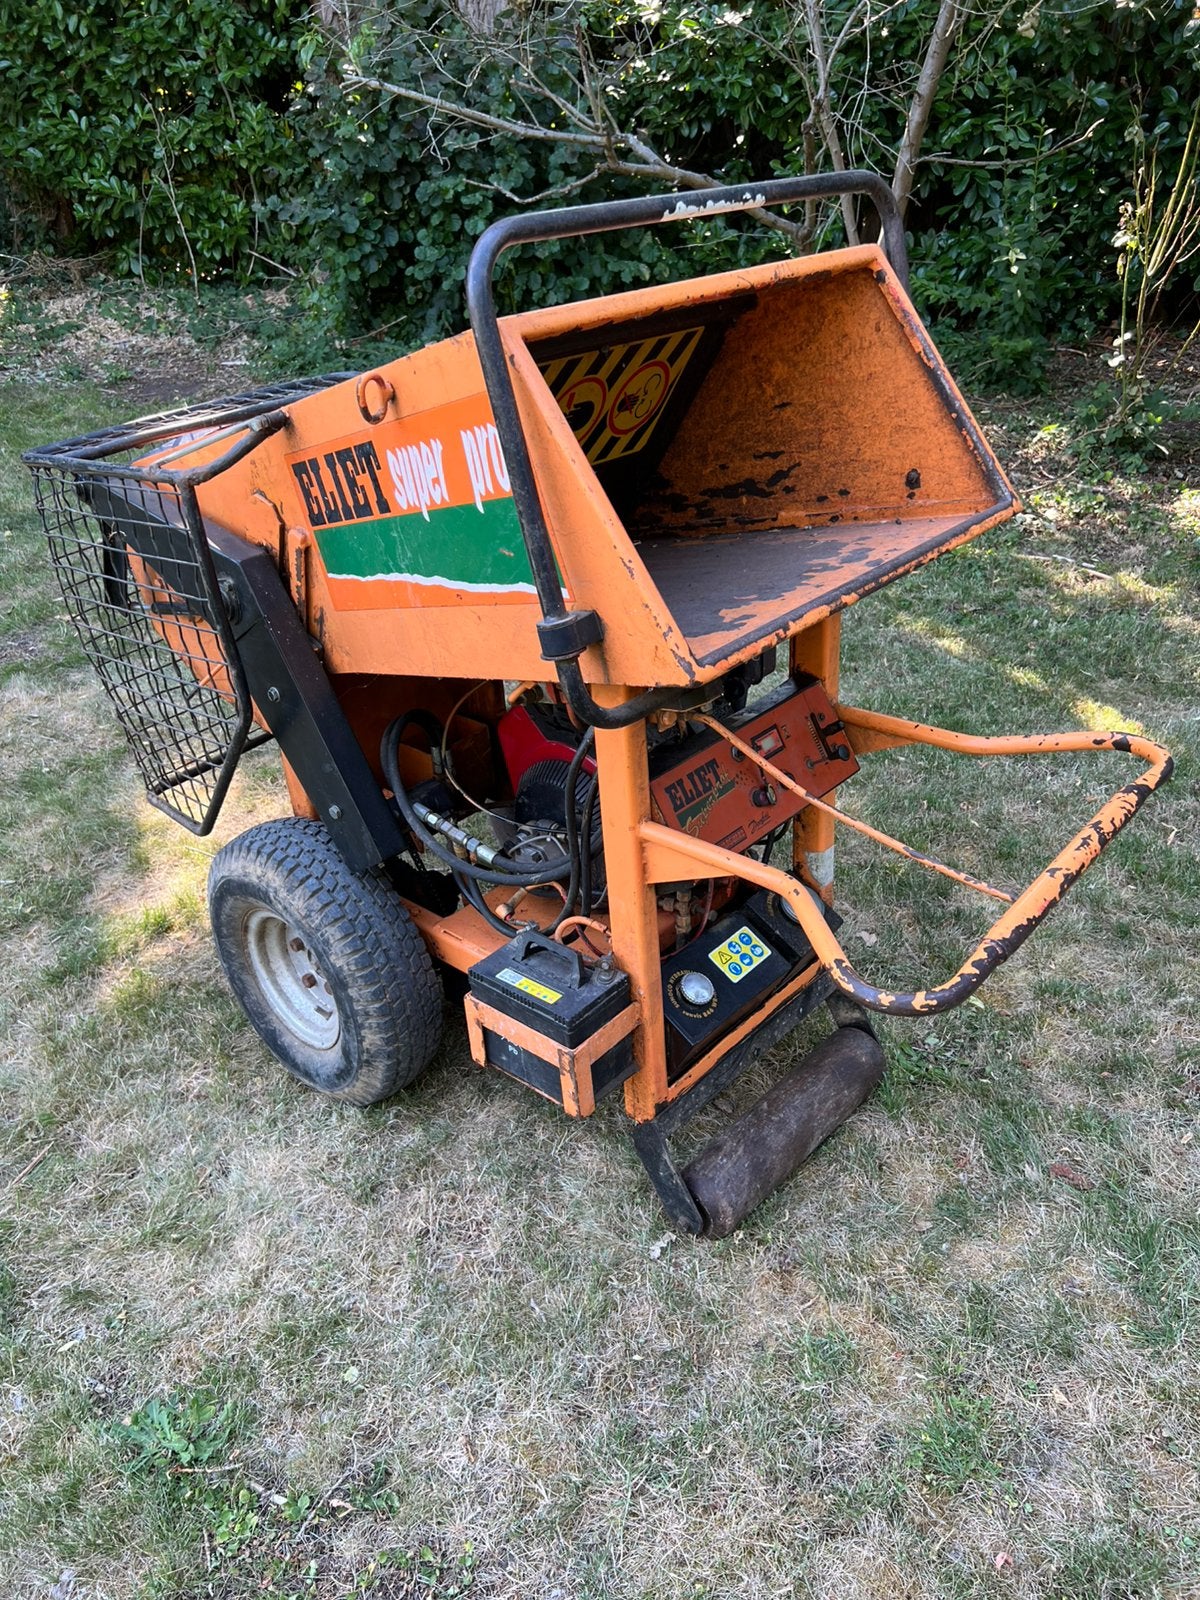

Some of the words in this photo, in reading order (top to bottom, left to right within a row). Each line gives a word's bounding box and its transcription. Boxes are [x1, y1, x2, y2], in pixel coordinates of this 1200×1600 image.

[291, 440, 391, 527] ELIET
[386, 437, 450, 522] super
[664, 759, 720, 812] ELIET
